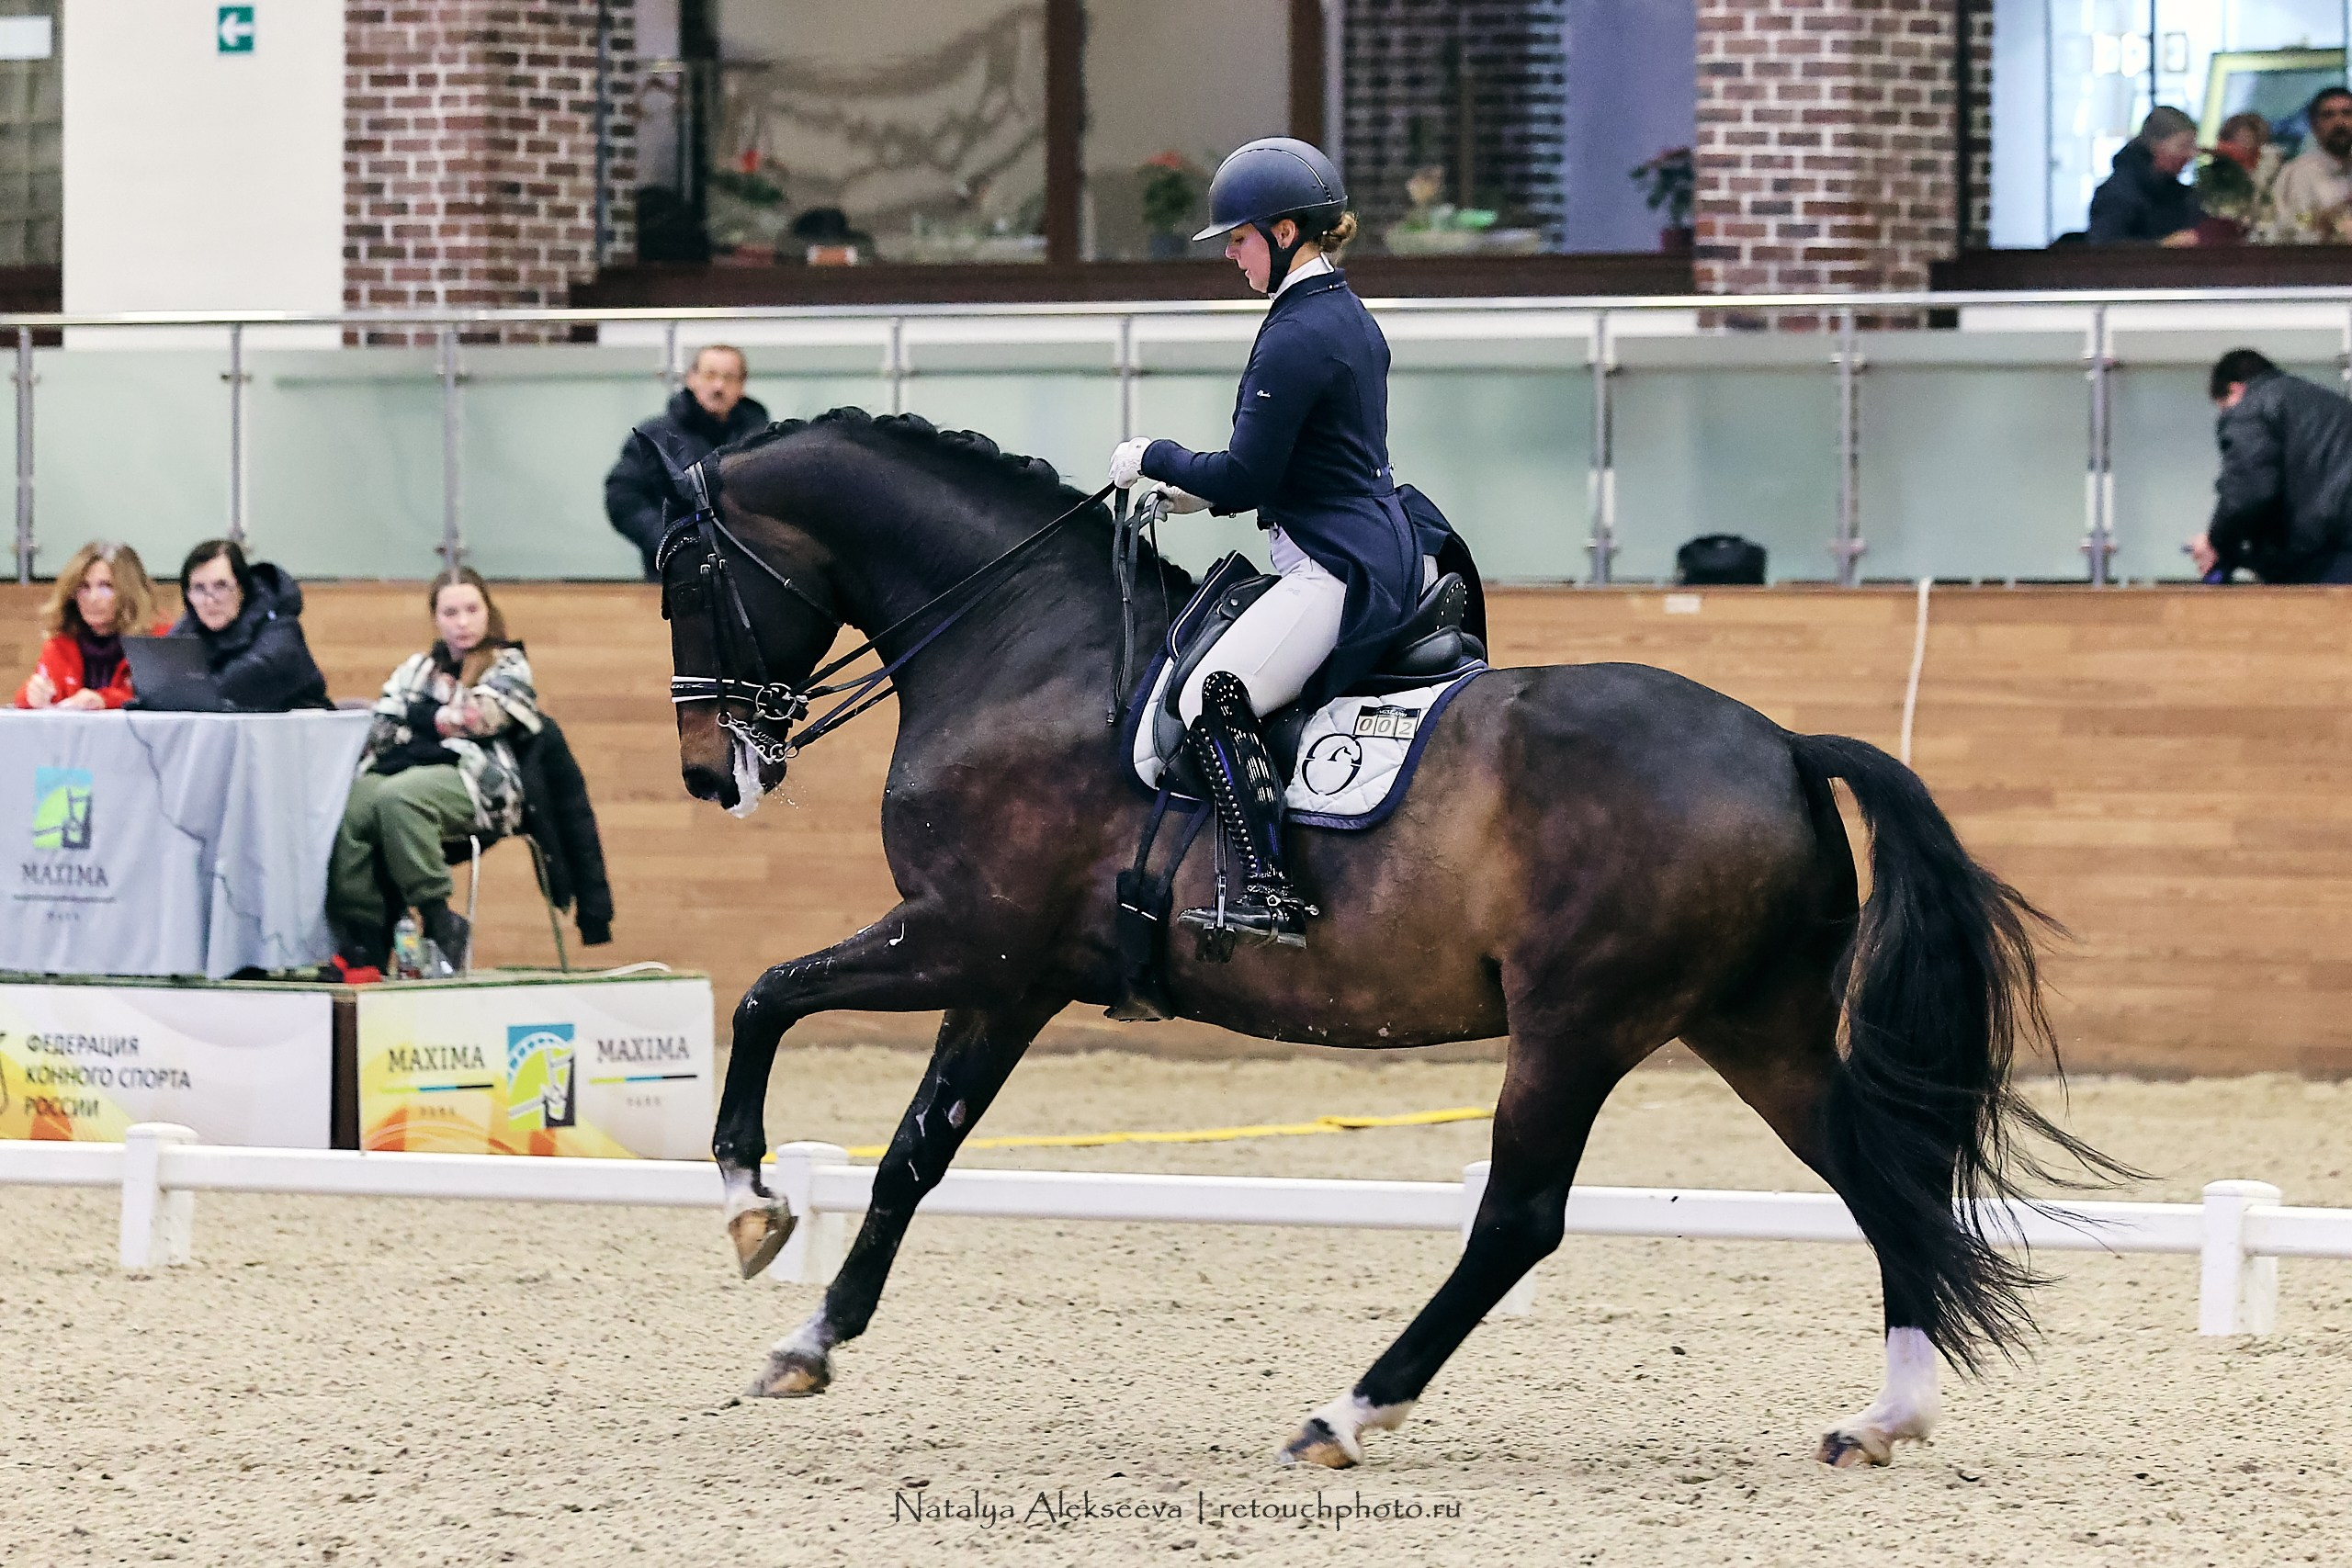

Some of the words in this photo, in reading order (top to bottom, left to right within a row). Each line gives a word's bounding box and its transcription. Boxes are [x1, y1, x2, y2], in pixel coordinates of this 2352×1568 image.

[1359, 717, 1413, 735] 002
[26, 1033, 139, 1057] ФЕДЕРАЦИЯ
[596, 1036, 690, 1064] MAXIMA
[388, 1044, 486, 1073] MAXIMA
[26, 1066, 114, 1088] КОННОГО
[119, 1067, 191, 1089] СПОРТА
[25, 1095, 99, 1117] РОССИИ
